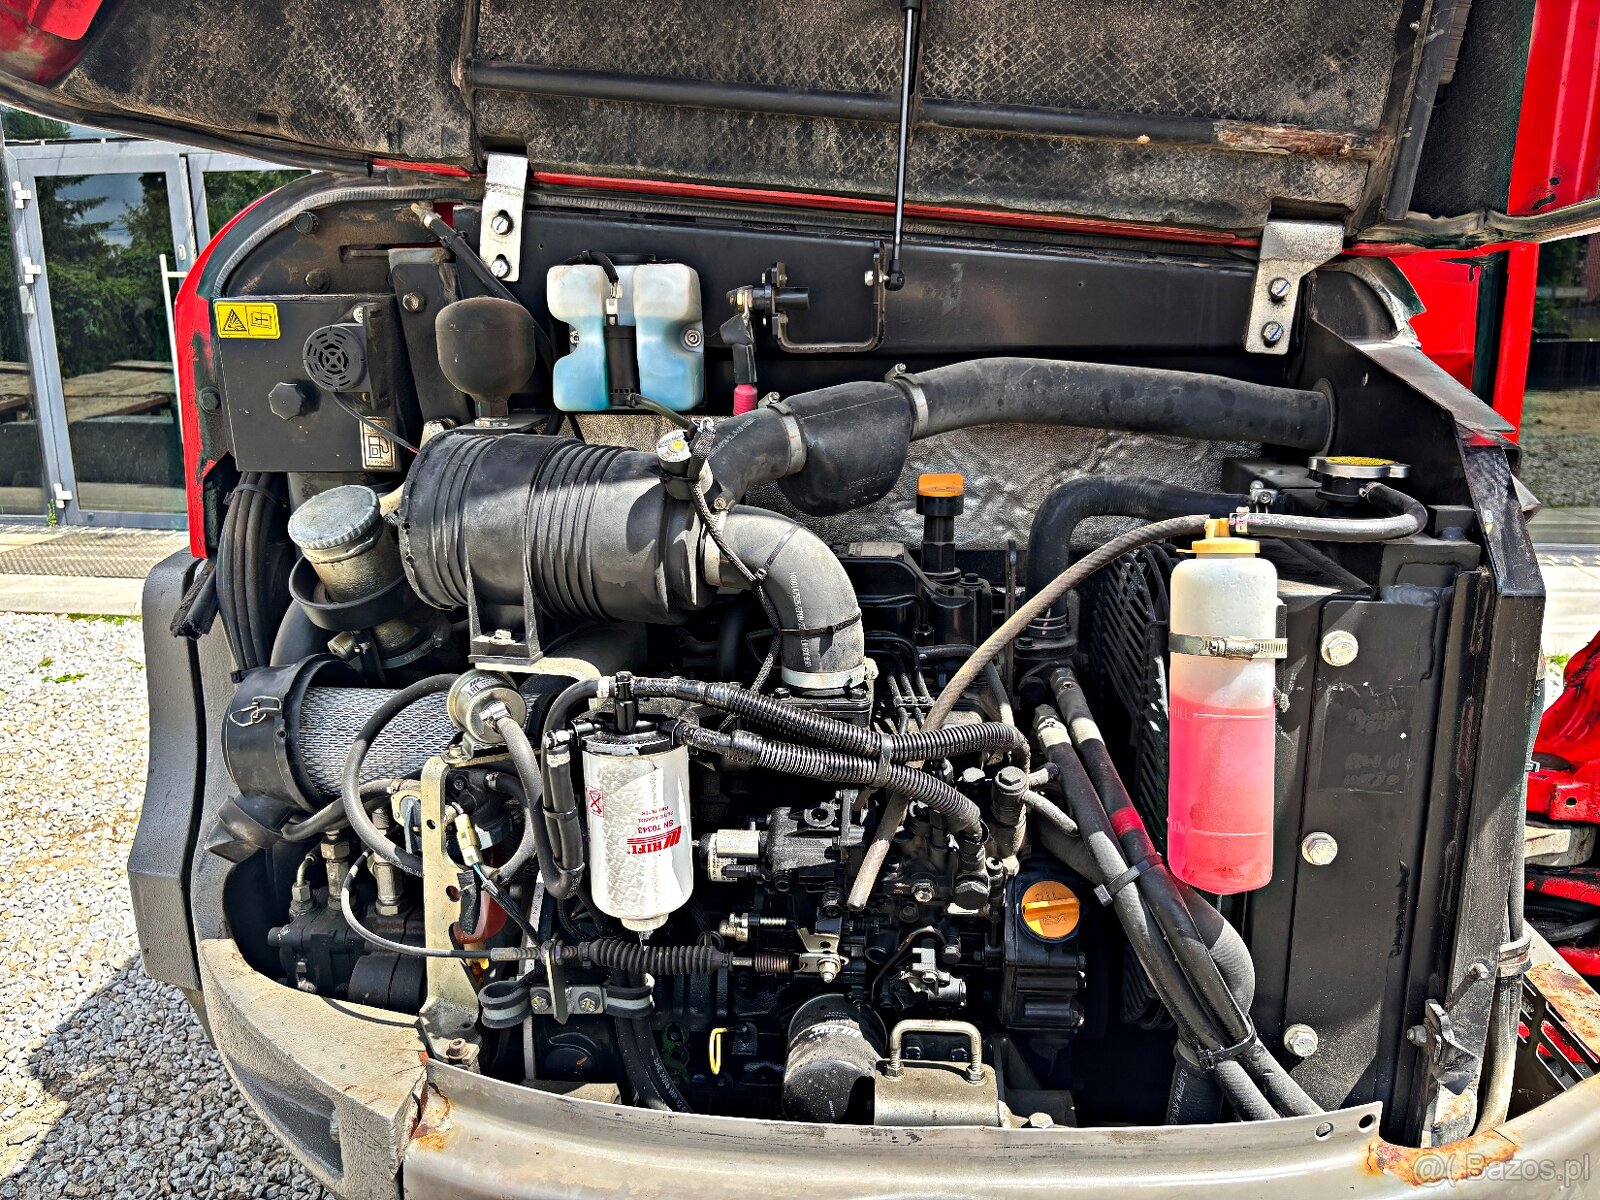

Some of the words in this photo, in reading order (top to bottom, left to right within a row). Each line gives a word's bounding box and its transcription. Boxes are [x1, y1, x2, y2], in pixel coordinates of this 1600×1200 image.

[1263, 515, 1287, 526] SAE
[664, 820, 674, 829] SN
[631, 841, 662, 854] HIFI
